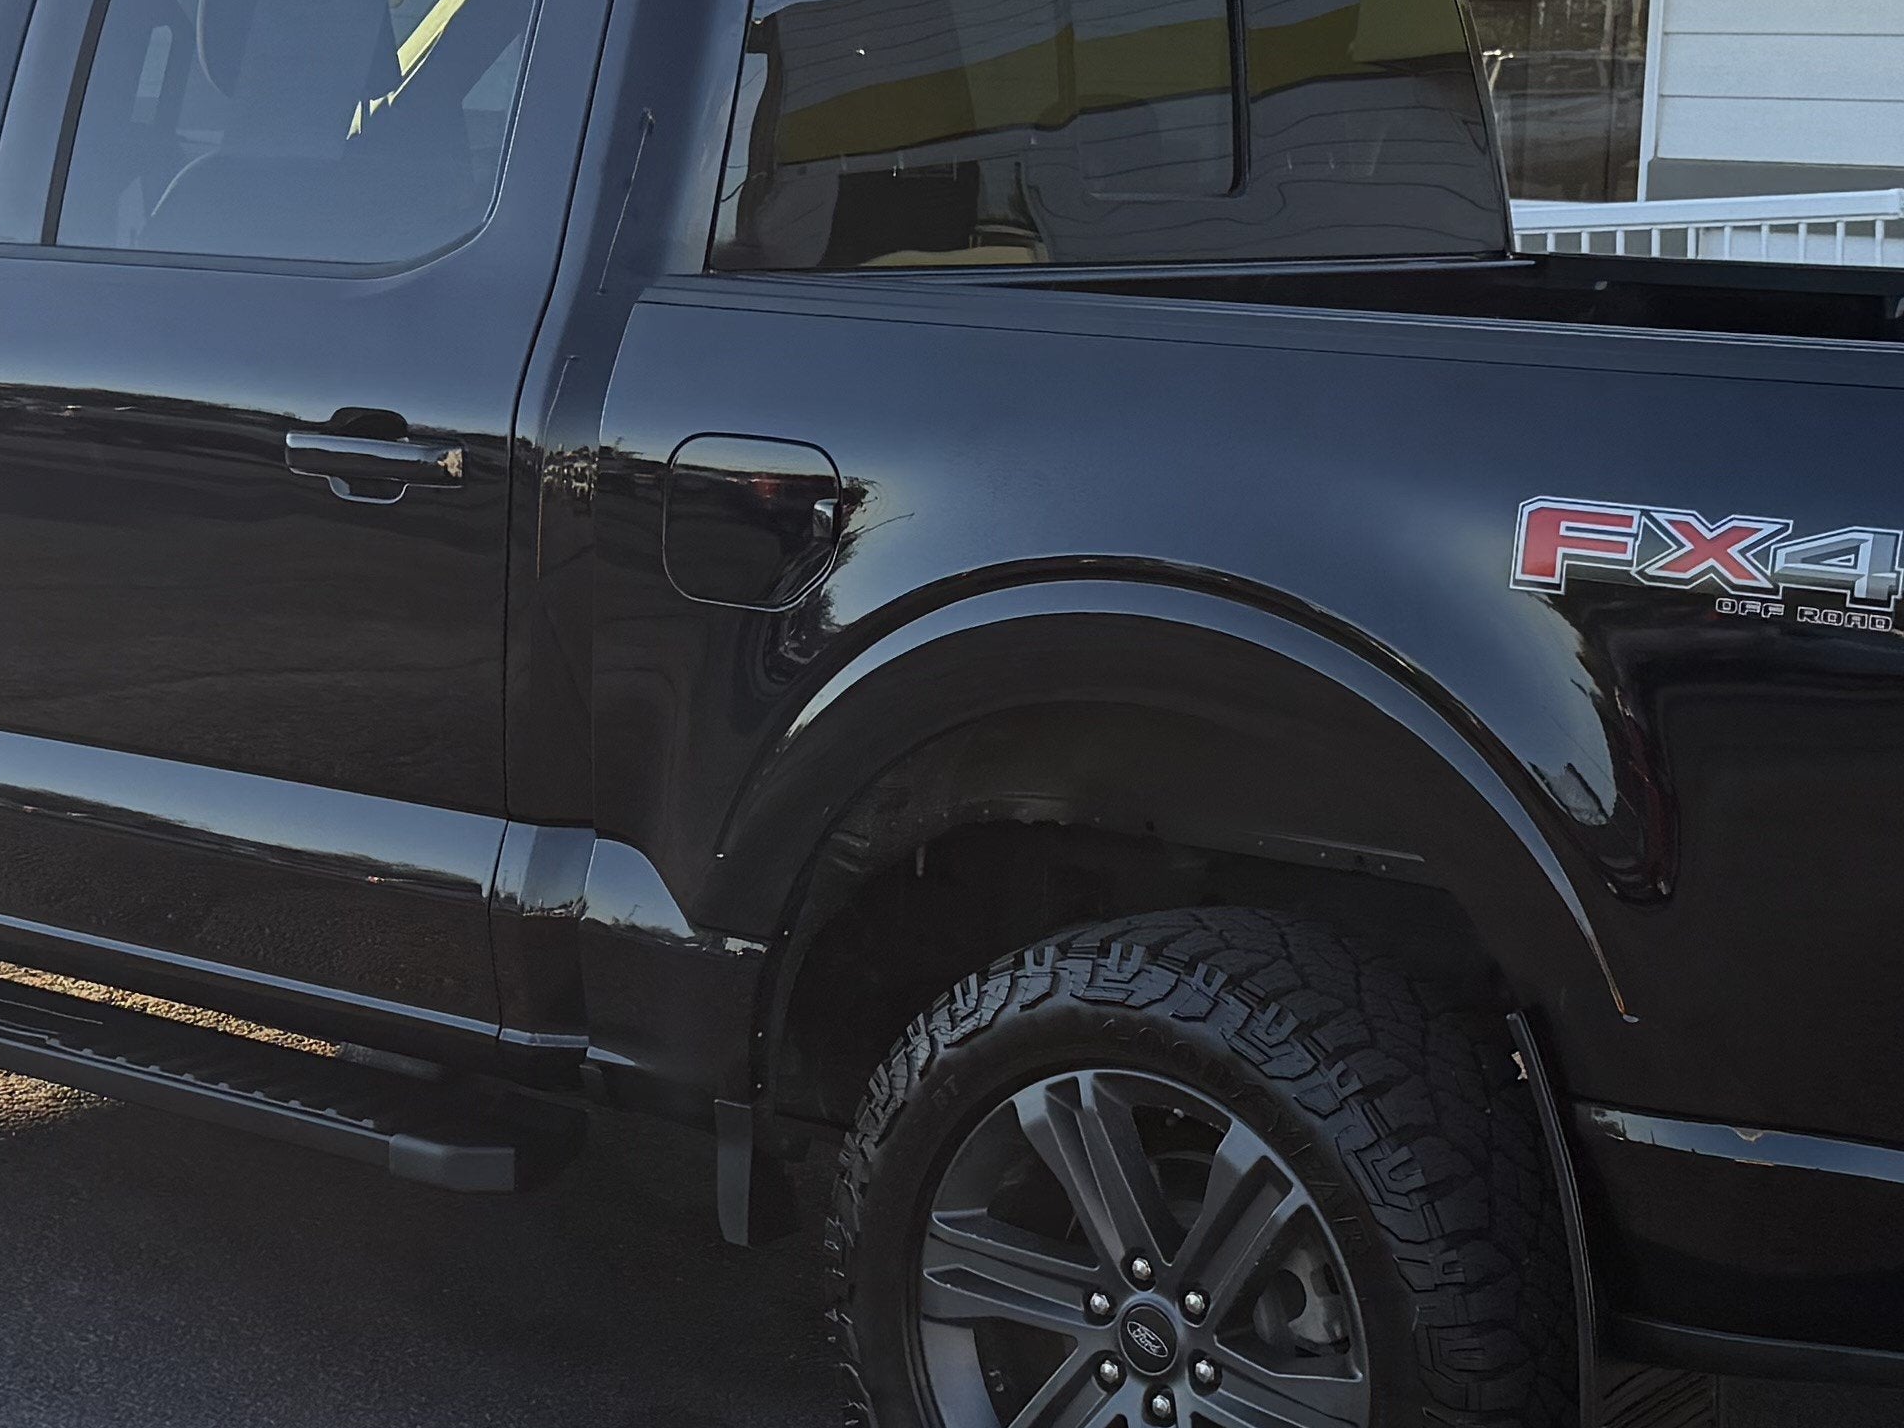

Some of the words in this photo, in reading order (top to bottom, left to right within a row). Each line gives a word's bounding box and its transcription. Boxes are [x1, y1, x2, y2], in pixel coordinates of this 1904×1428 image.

[1509, 495, 1903, 611] FX4
[1715, 597, 1786, 619] OFF
[1796, 605, 1894, 633] ROAD
